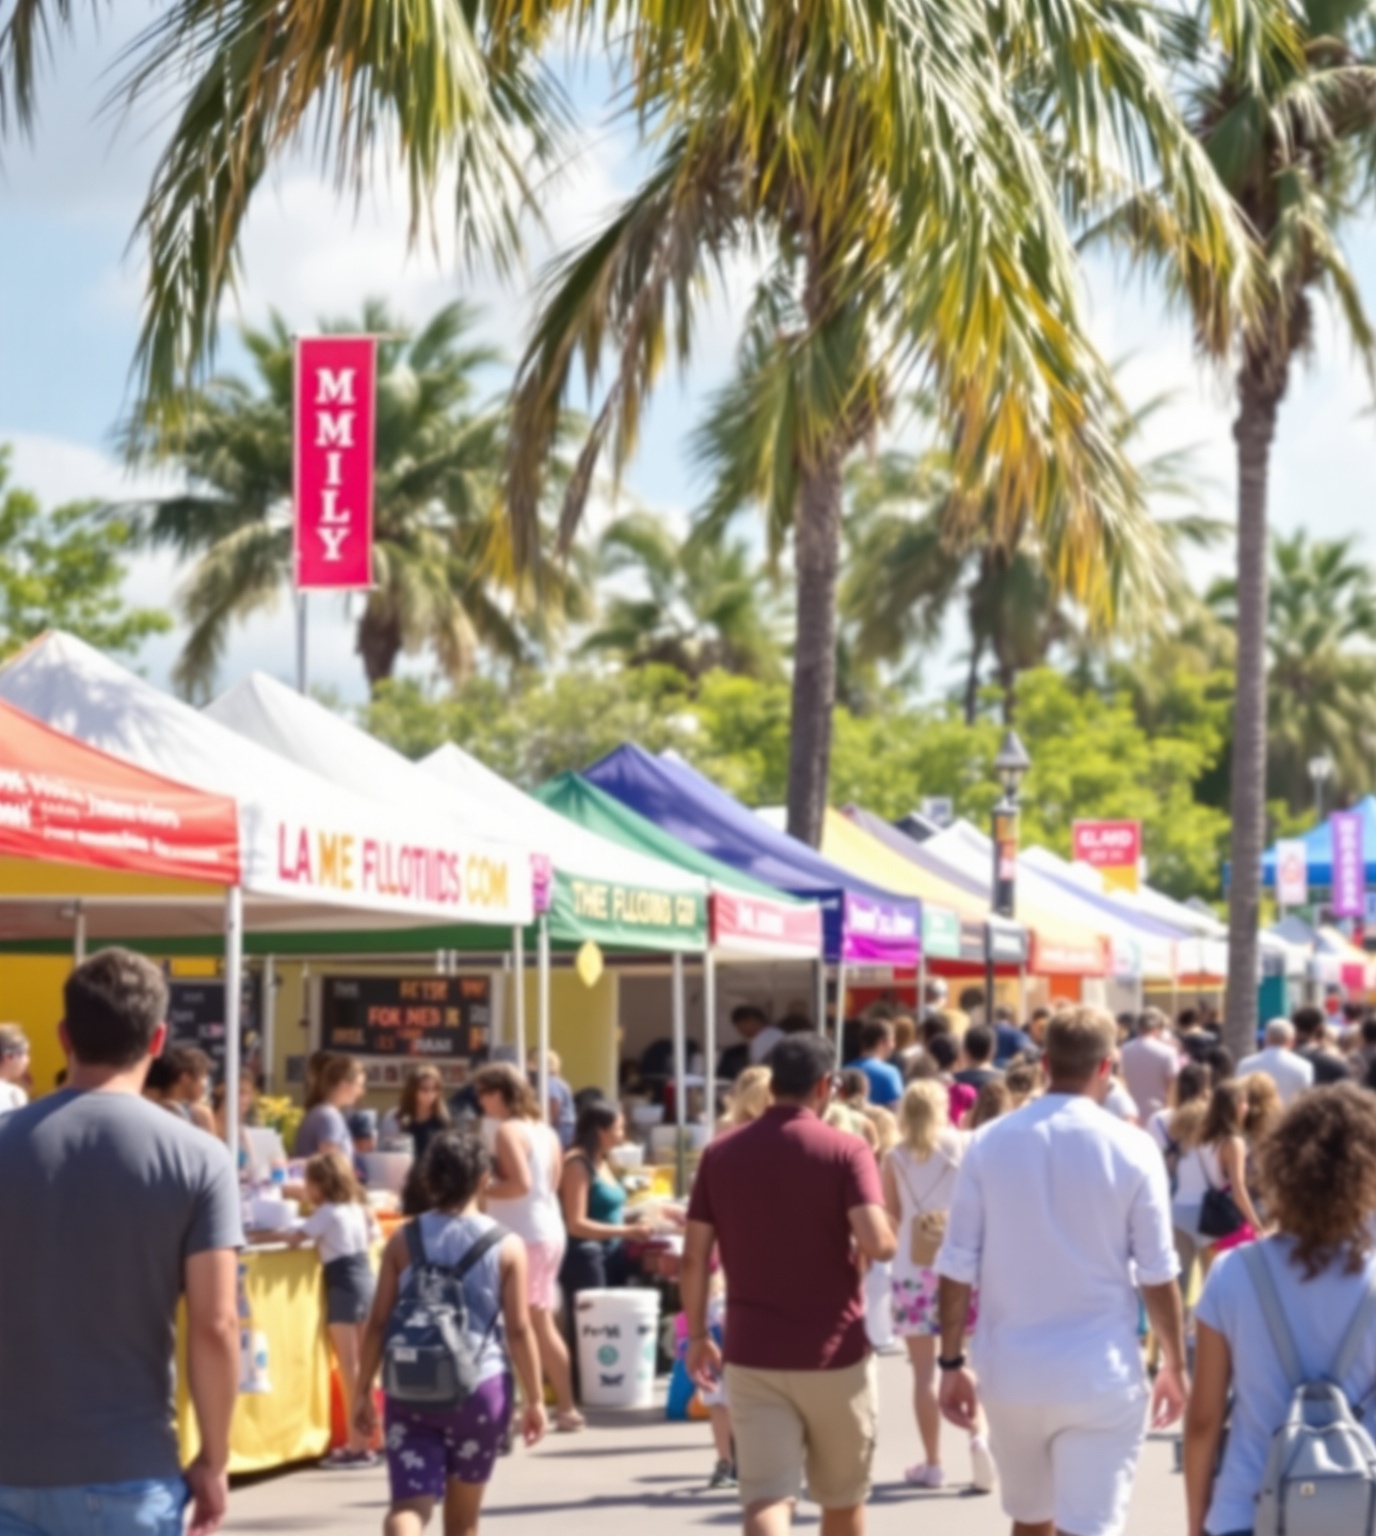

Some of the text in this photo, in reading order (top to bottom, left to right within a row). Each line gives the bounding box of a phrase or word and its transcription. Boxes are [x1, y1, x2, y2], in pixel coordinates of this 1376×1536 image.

[315, 367, 356, 562] MMILY
[279, 821, 313, 885] LA
[318, 829, 354, 891] ME
[466, 853, 509, 909] COM
[571, 879, 609, 921] THE
